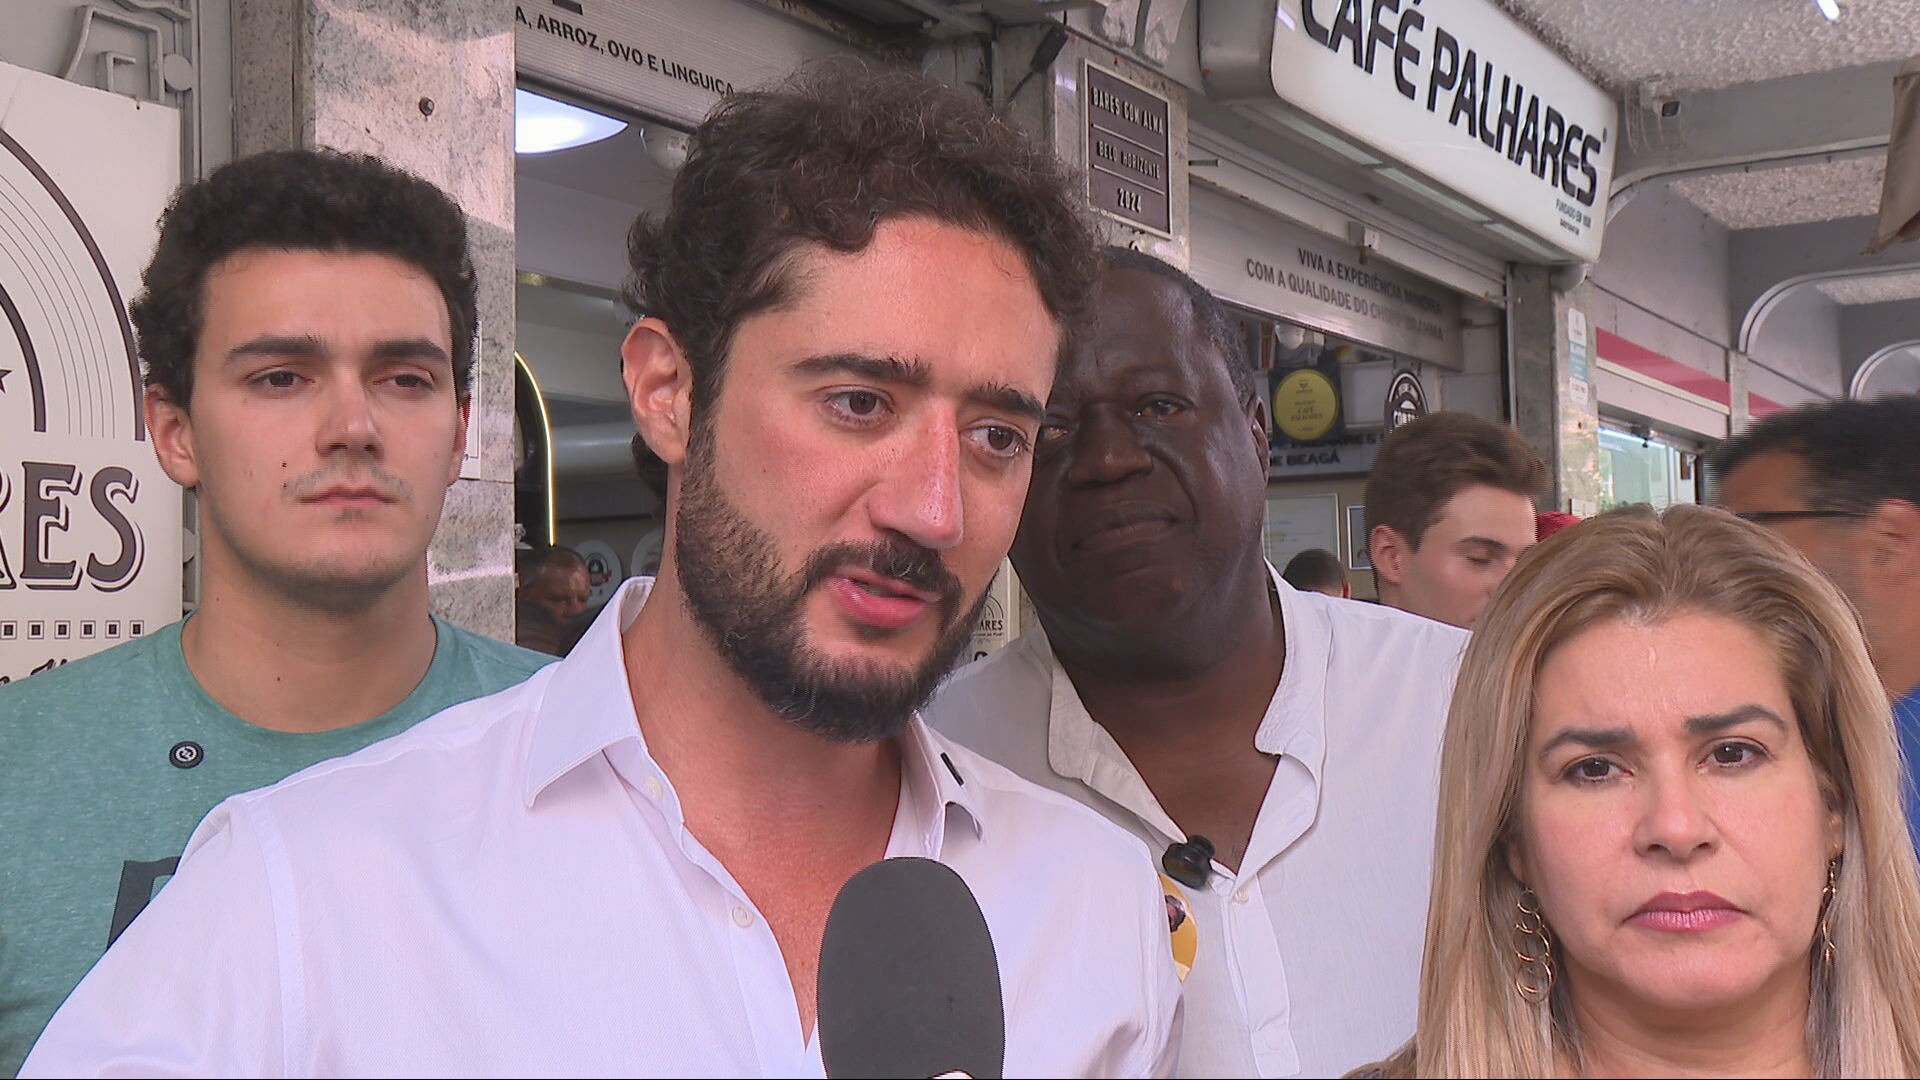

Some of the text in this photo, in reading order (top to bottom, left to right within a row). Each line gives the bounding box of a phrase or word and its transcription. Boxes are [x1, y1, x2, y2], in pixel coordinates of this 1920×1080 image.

[537, 14, 604, 55] ARROZ,
[607, 39, 643, 66] OVO
[647, 54, 658, 72] E
[661, 58, 735, 100] LINGUIÇA
[1092, 86, 1164, 137] BARES COM ALMA
[1427, 26, 1601, 207] PALHARES
[1098, 140, 1160, 180] BELO HORIZONTE
[1118, 187, 1142, 214] 2024
[1247, 258, 1275, 285] COM
[1278, 271, 1287, 290] A
[1288, 272, 1351, 311] QUALIDADE
[1354, 296, 1369, 316] DO
[1299, 247, 1325, 273] VIVA
[1327, 259, 1335, 276] A
[1337, 261, 1402, 299] EXPERIÊNCIA
